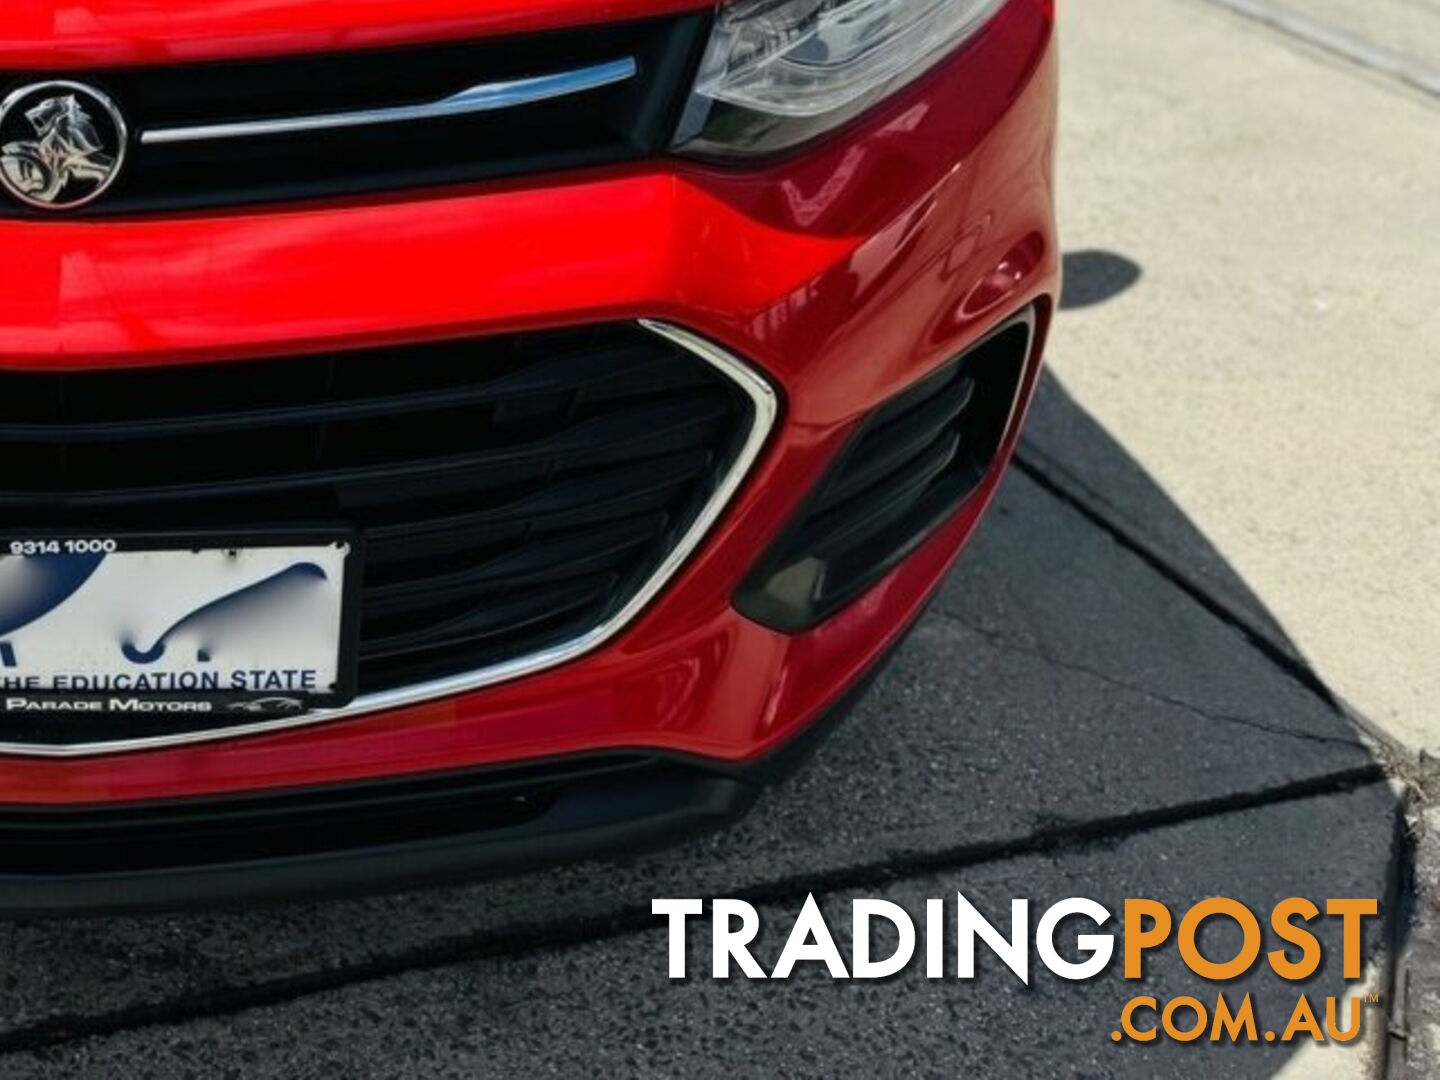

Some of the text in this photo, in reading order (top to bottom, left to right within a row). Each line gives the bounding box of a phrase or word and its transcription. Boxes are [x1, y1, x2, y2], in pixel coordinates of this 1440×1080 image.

[10, 539, 116, 554] 9314 1000
[53, 671, 218, 691] EDUCATION
[231, 669, 316, 690] STATE
